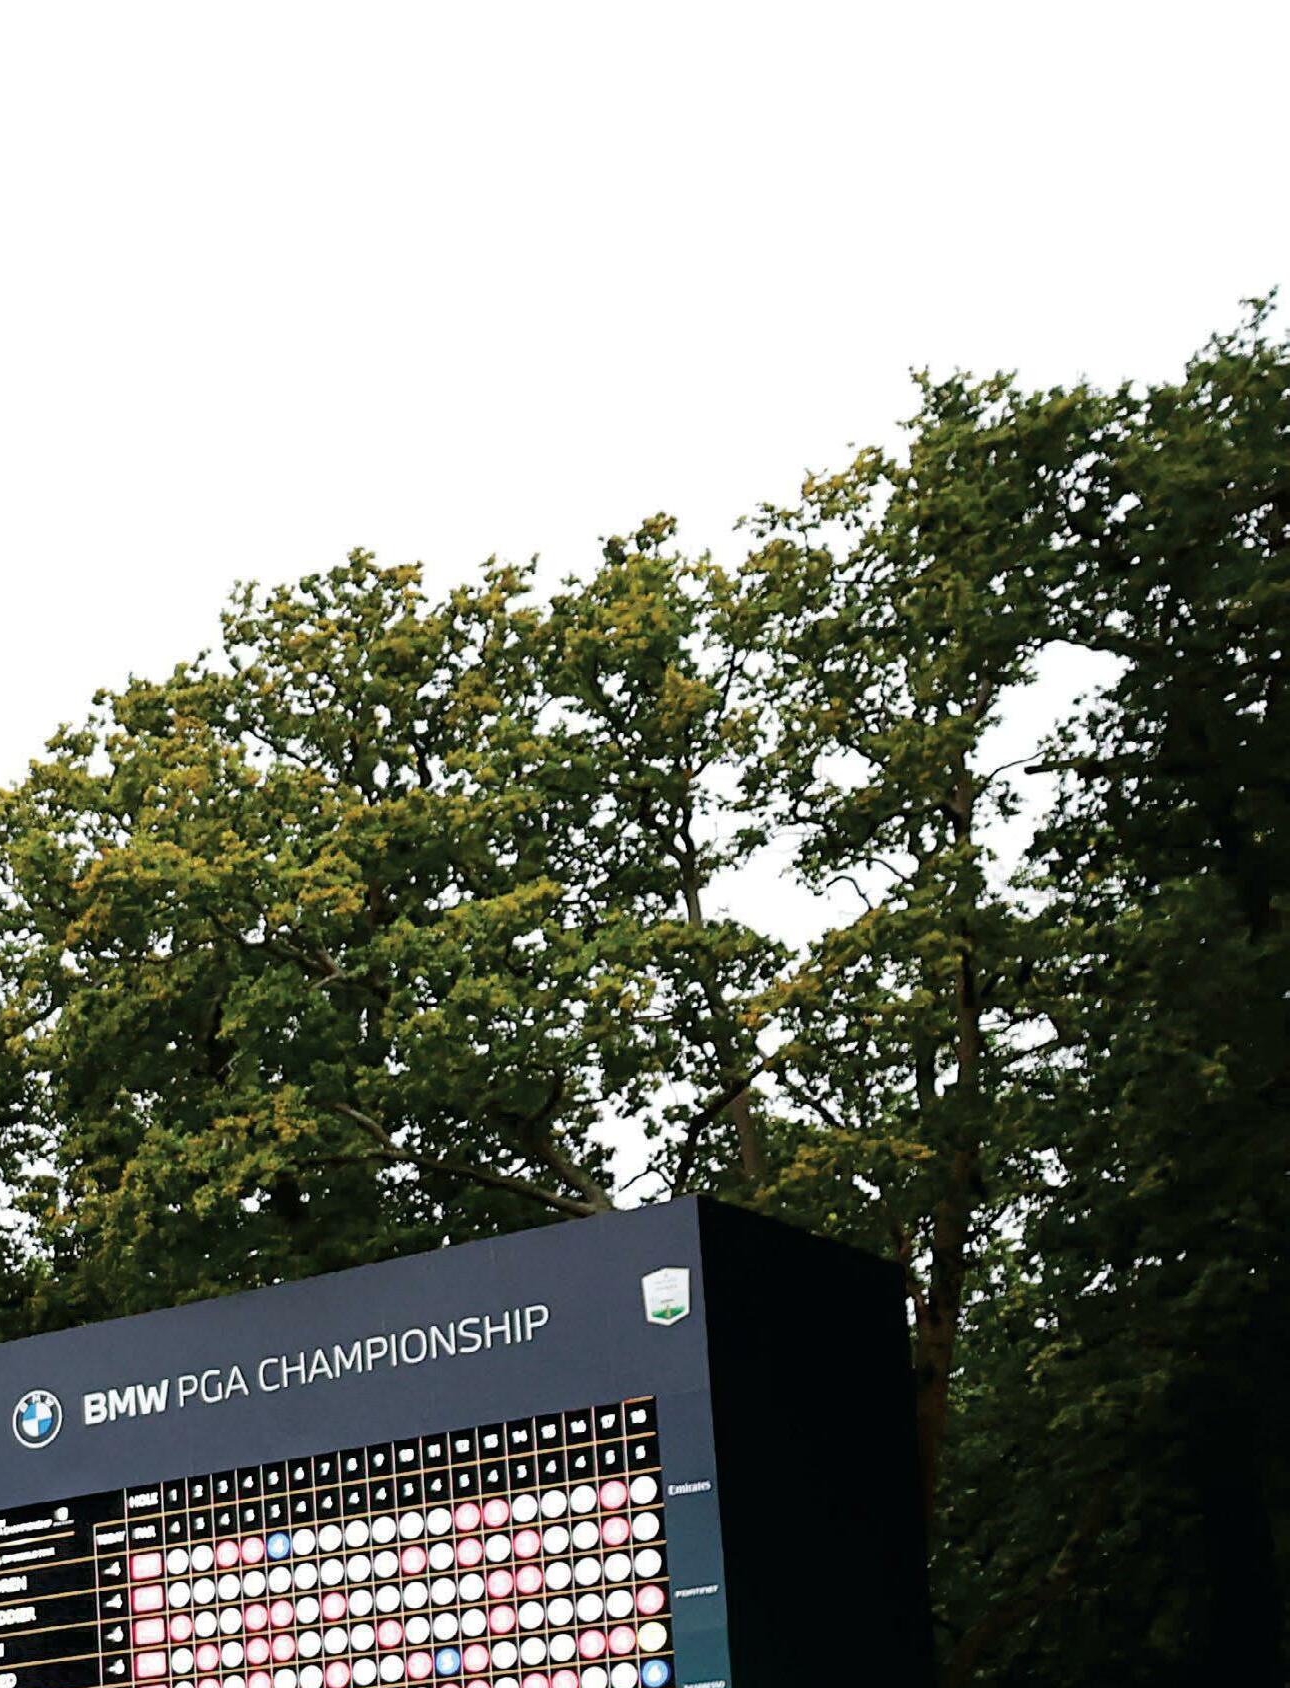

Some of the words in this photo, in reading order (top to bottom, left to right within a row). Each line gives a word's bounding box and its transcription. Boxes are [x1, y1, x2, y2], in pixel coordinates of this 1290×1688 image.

[83, 1379, 170, 1425] BMW
[178, 1366, 250, 1407] PGA
[257, 1304, 551, 1393] CHAMPIONSHIP
[668, 1480, 712, 1495] Emirates
[129, 1491, 159, 1509] HOLE
